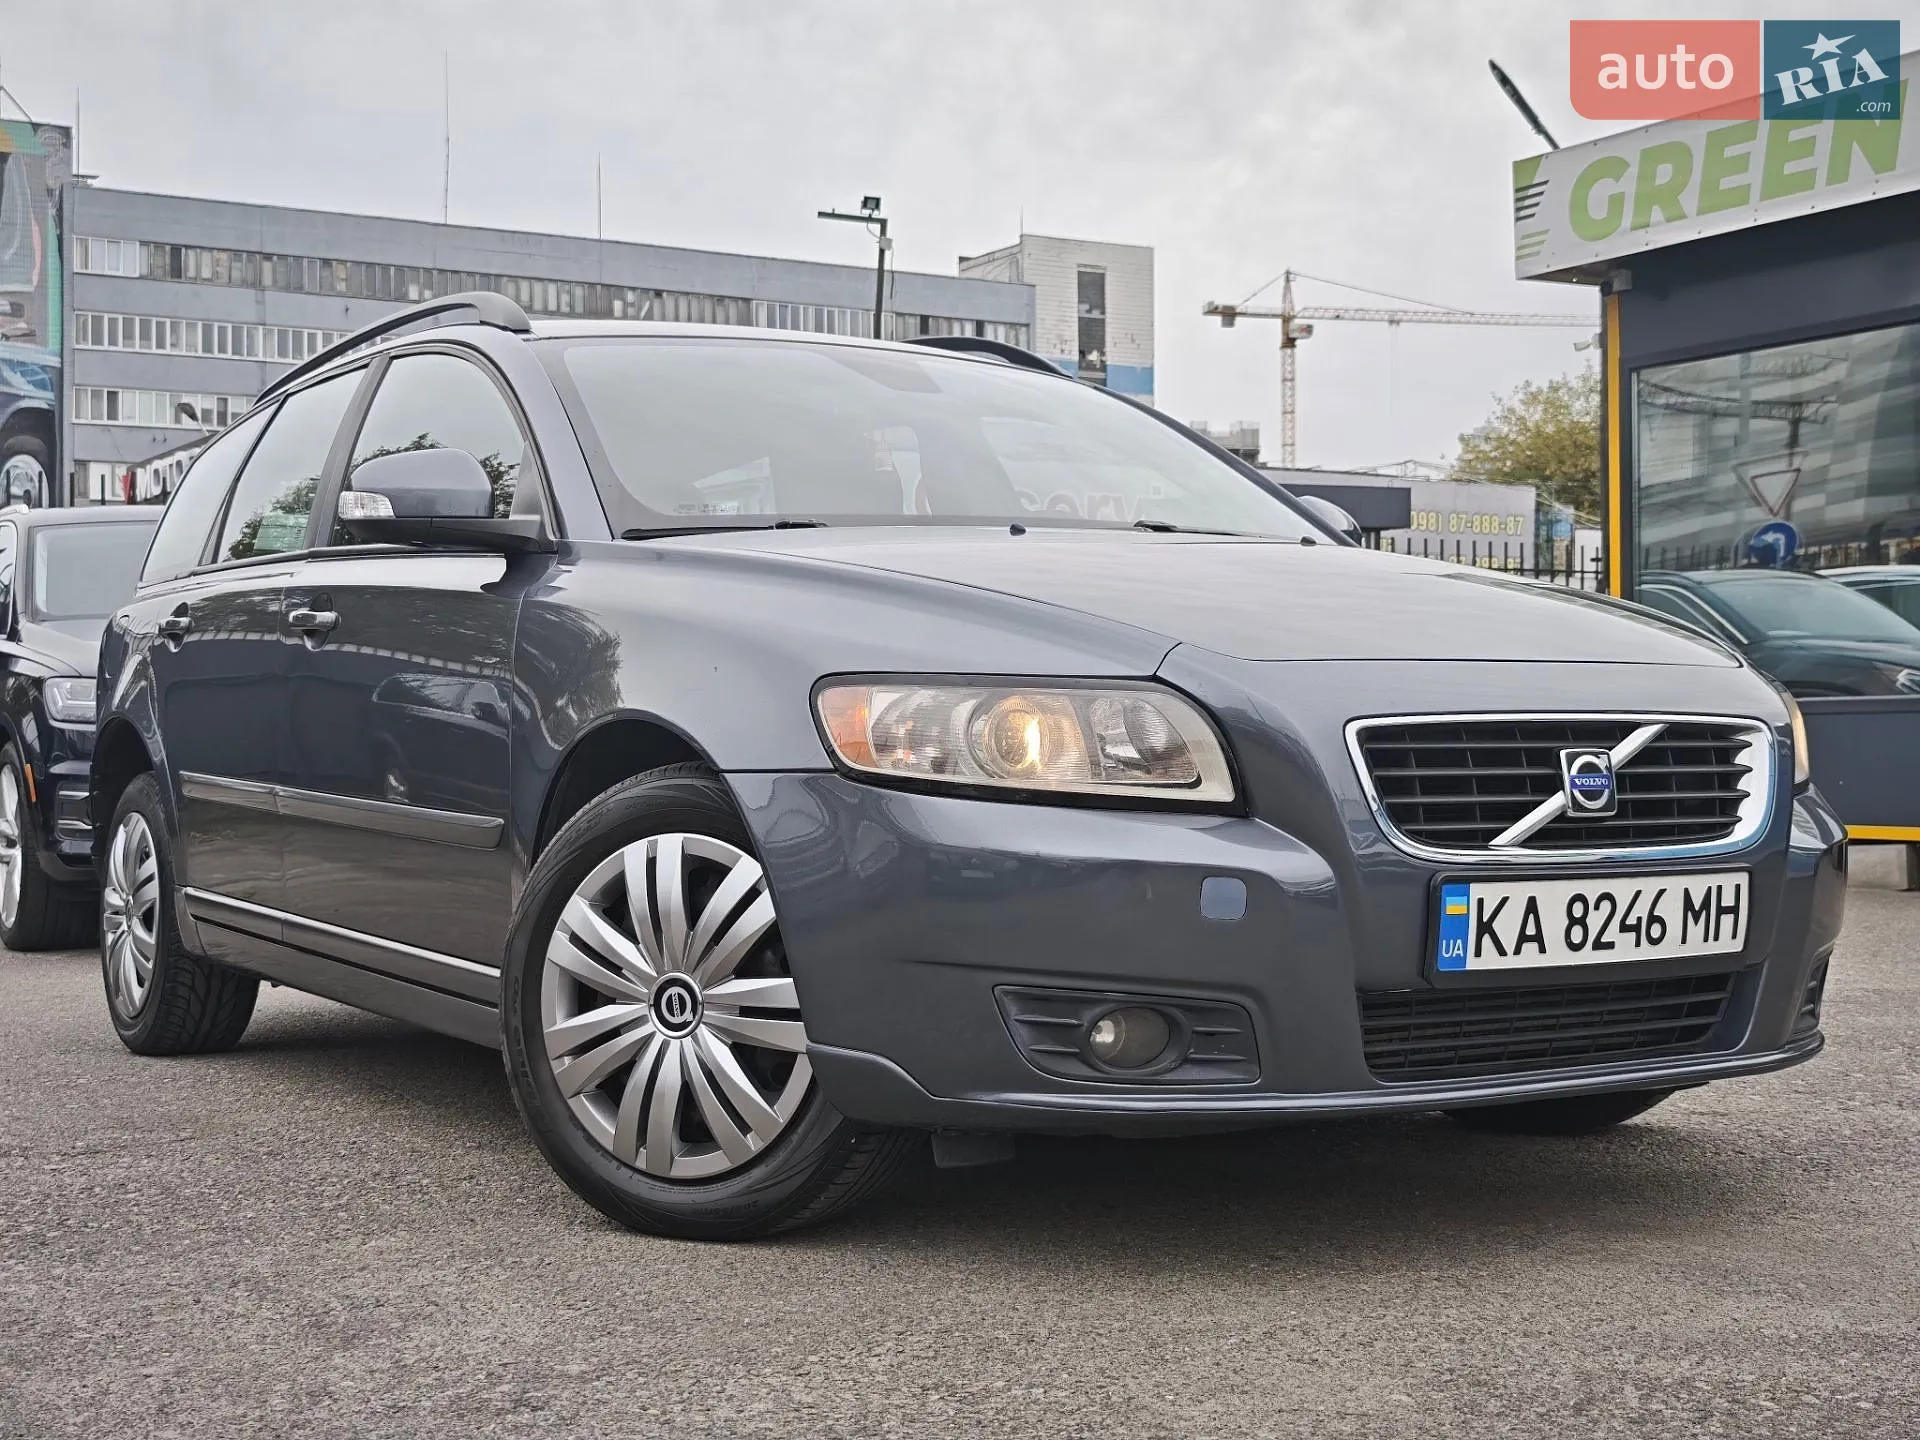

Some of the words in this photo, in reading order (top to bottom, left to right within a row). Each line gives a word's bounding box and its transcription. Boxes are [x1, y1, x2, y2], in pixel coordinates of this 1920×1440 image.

[1569, 80, 1907, 242] GREEN
[1449, 512, 1525, 536] 87-888-87
[1572, 777, 1609, 786] VOLVO
[1474, 895, 1547, 957] KA
[1564, 888, 1668, 952] 8246
[1680, 883, 1741, 945] MH
[1441, 939, 1464, 957] UA
